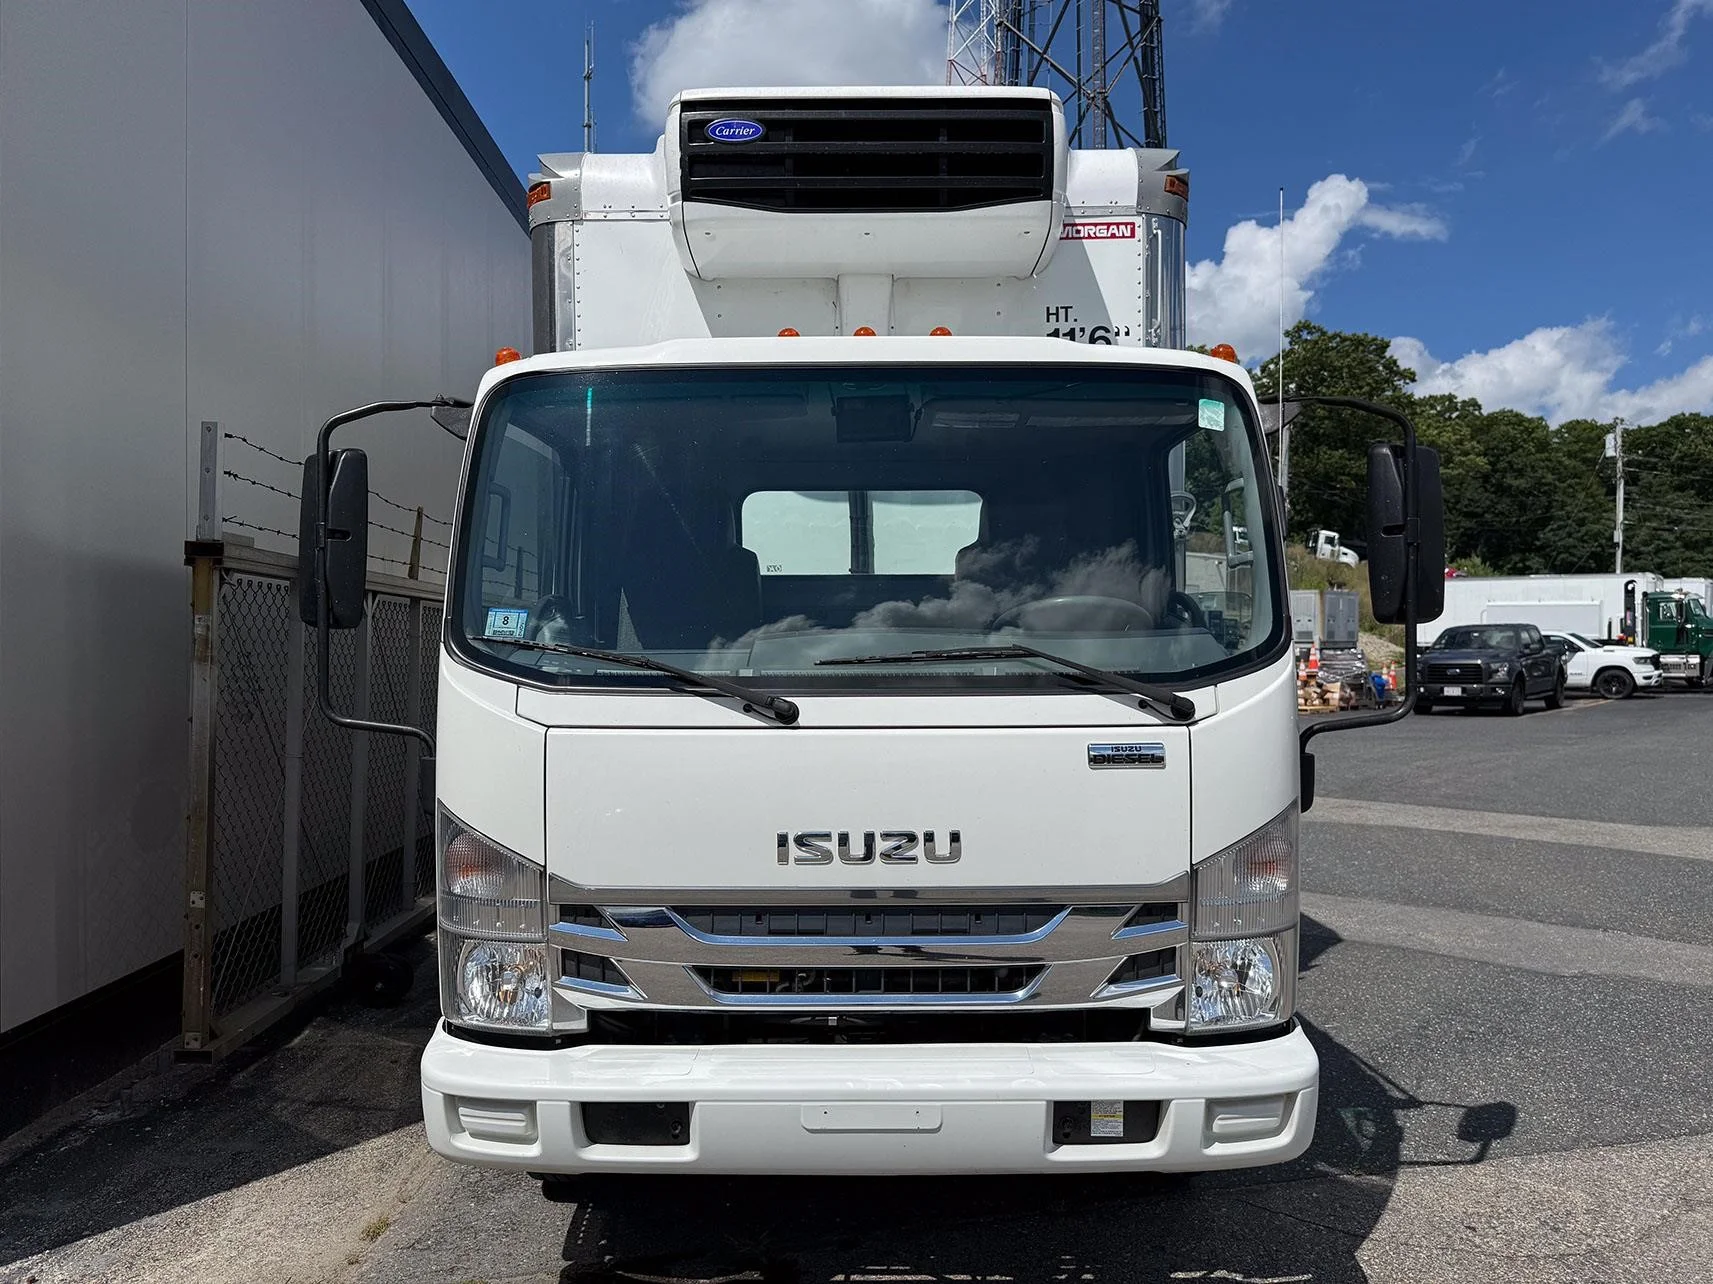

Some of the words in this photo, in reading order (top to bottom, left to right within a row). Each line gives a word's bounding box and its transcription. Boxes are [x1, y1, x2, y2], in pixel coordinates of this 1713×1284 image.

[715, 126, 756, 136] Carrier
[1045, 305, 1078, 323] HT.
[502, 615, 510, 626] 8
[1111, 745, 1142, 753] ISUZU
[1092, 753, 1165, 764] DIESEL
[776, 829, 962, 866] ISUZU
